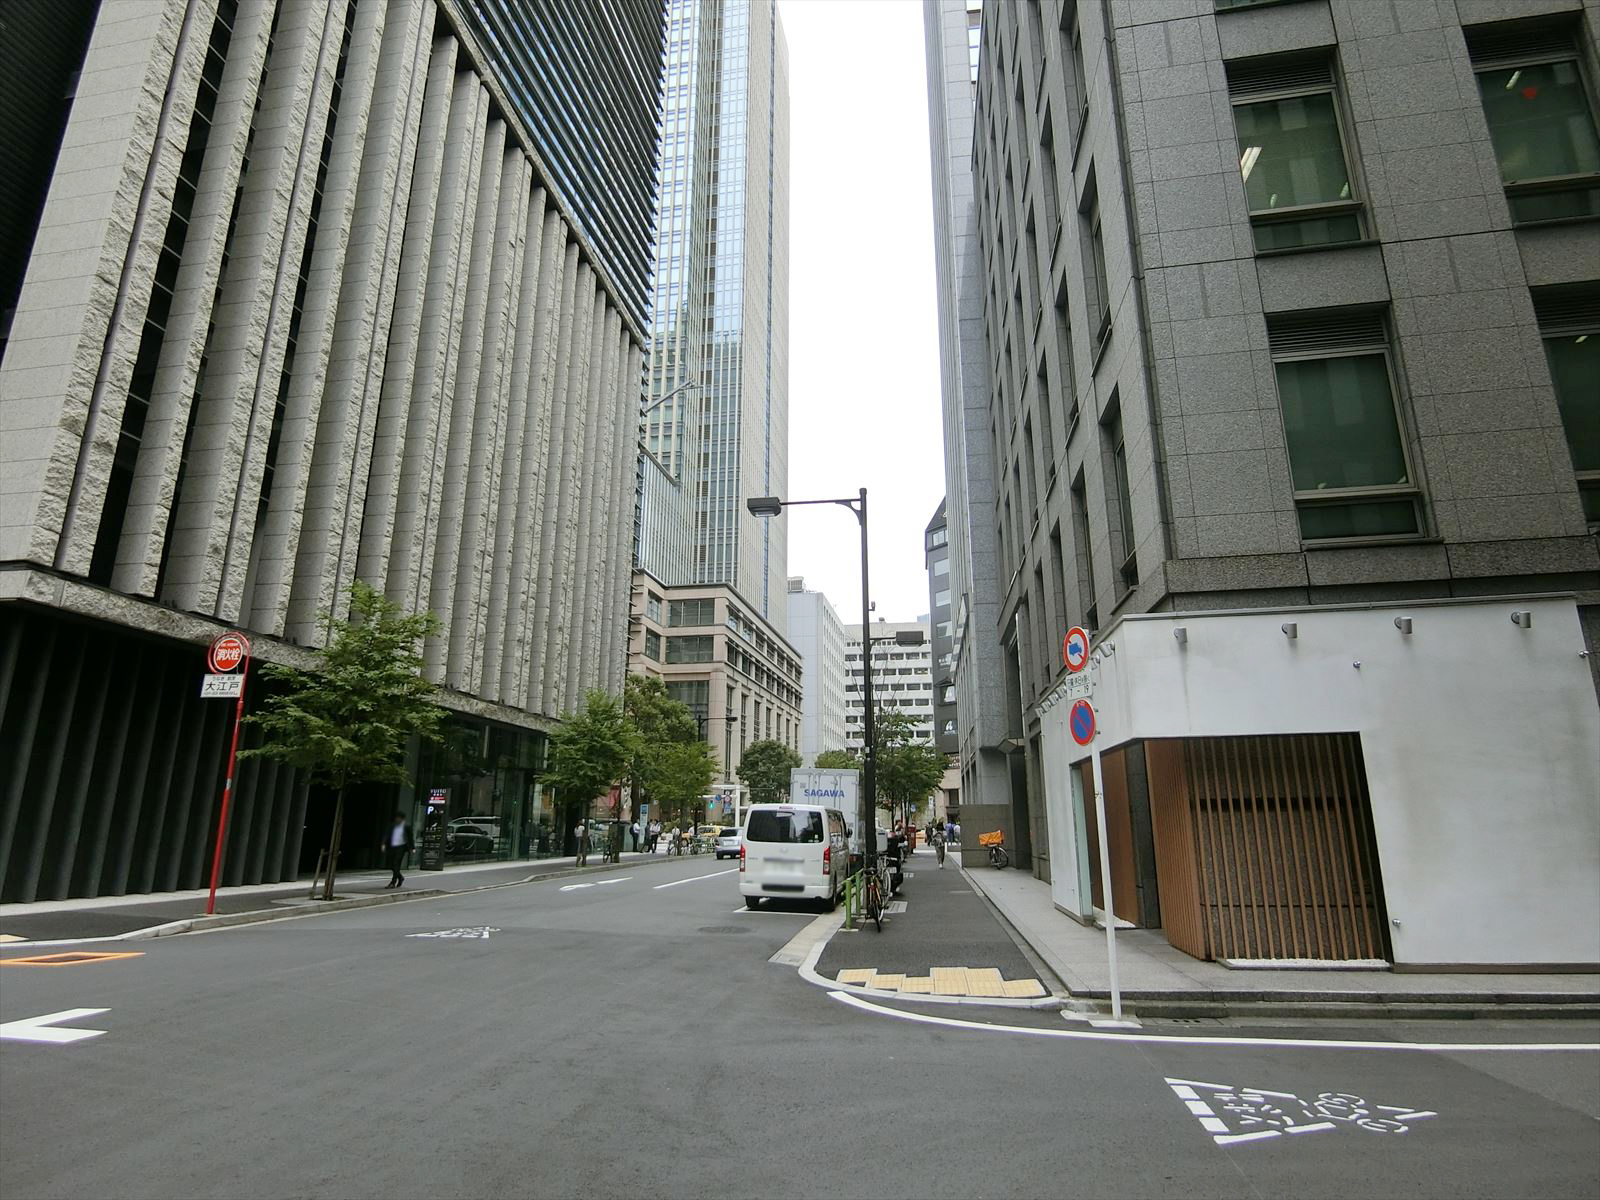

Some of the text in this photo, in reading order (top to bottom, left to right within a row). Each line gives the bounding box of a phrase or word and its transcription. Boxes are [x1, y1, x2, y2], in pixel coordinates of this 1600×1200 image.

[216, 648, 240, 660] 消火栓
[205, 681, 240, 691] 大江戸
[804, 789, 845, 798] SAGAWA
[427, 806, 434, 815] P
